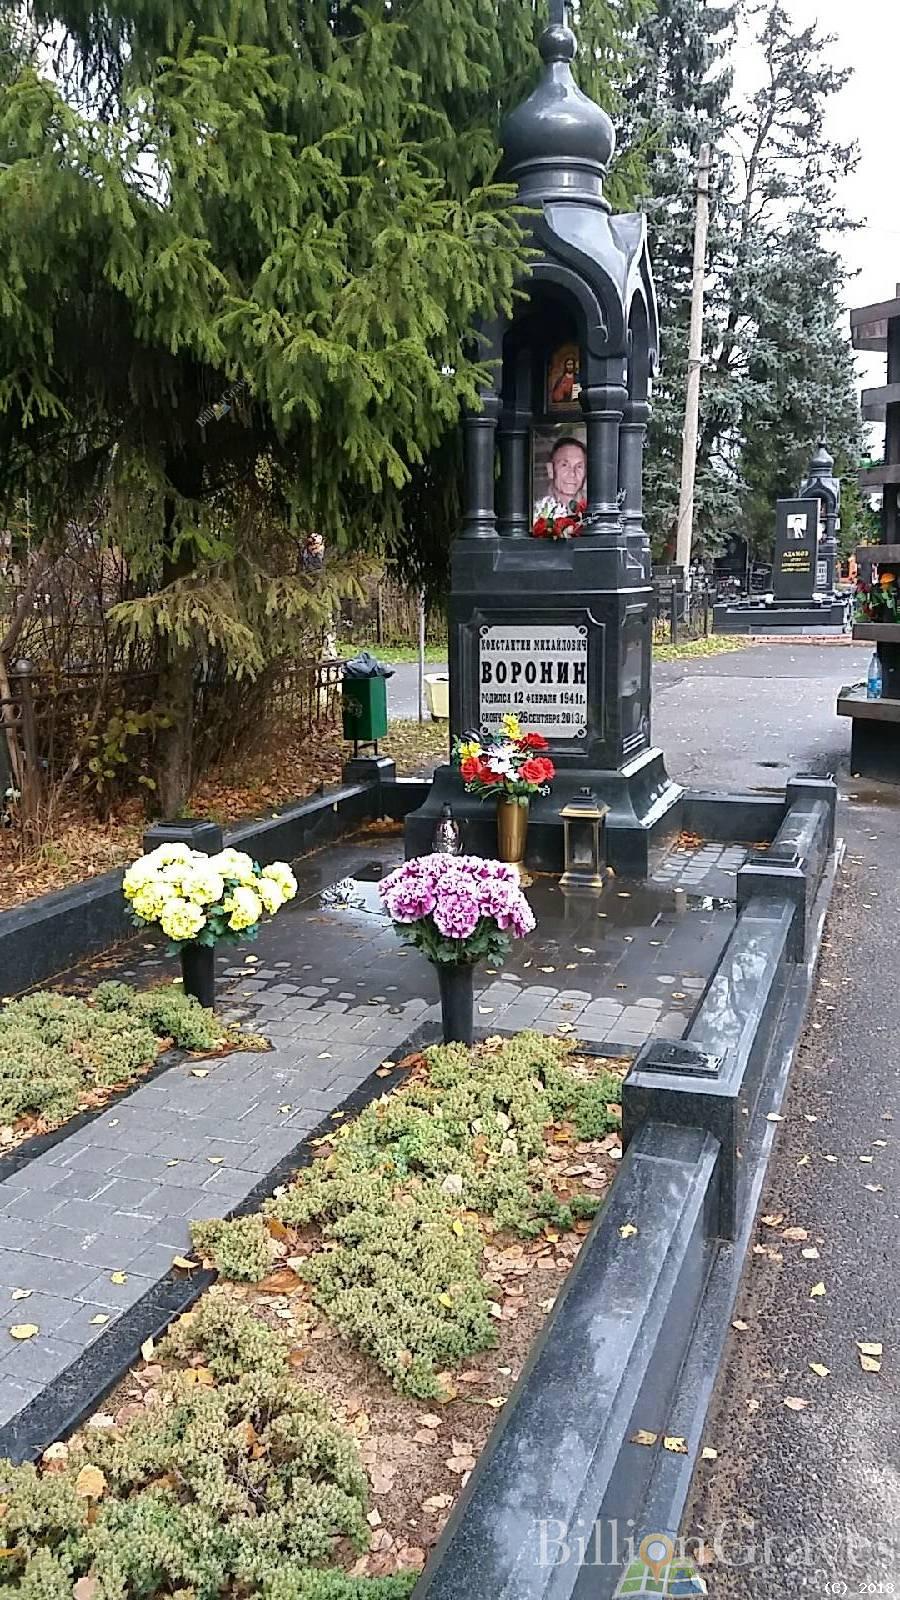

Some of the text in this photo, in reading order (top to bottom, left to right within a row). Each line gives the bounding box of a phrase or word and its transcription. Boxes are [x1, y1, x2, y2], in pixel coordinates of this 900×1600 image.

[481, 637, 587, 651] КОНСТАНТИН МИХАЙЛОВИЧ
[481, 660, 586, 684] ВОРОНИН
[481, 692, 511, 704] РОДИЛСЯ
[514, 691, 524, 704] 12
[526, 693, 557, 704] ФЕВРАЛЯ
[481, 712, 518, 723] СКОНЧ
[528, 712, 560, 723] СЕНТЯБРЯ
